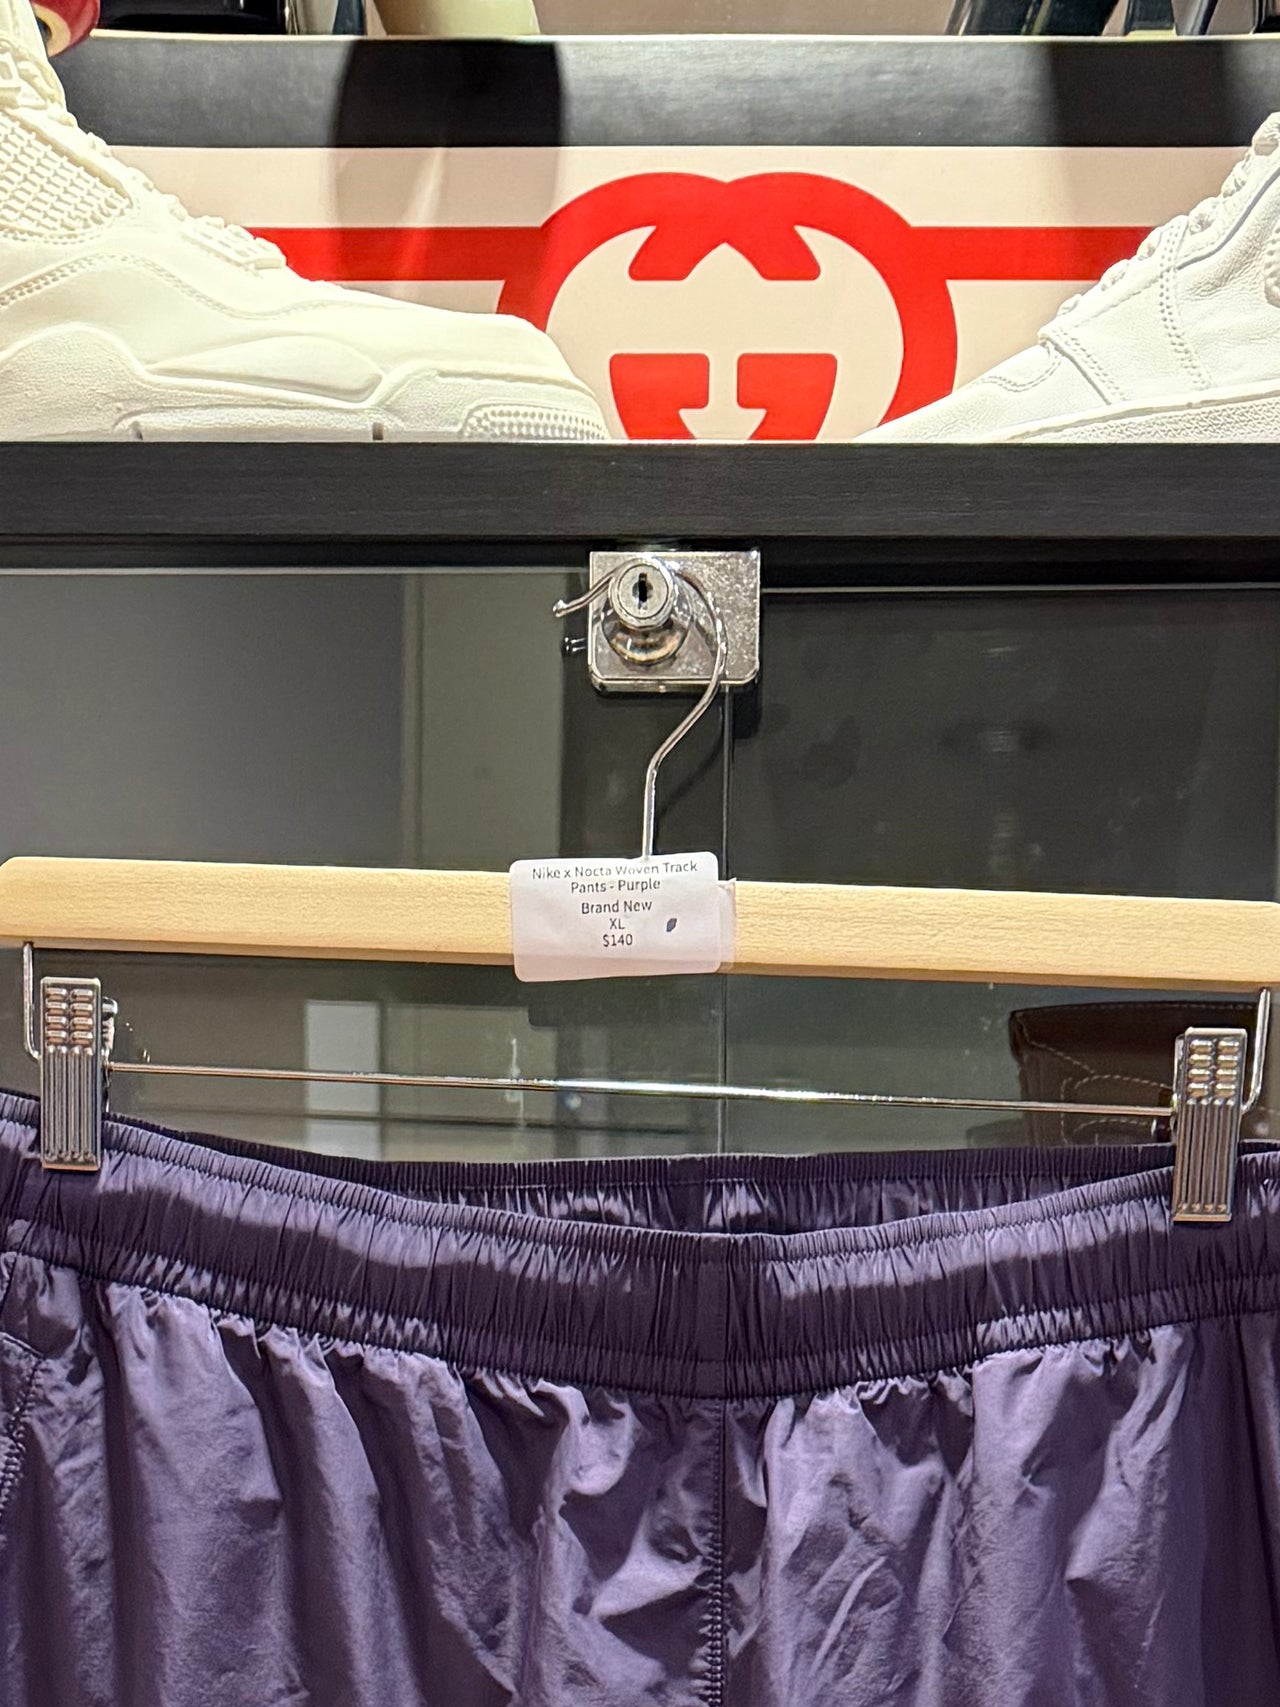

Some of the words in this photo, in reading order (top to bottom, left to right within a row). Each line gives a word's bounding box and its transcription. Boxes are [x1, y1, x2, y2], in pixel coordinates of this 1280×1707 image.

[532, 867, 561, 880] Nike
[564, 870, 571, 879] x
[575, 866, 612, 878] Nocta
[615, 865, 659, 876] Woven
[663, 860, 698, 874] Track
[571, 881, 607, 894] Pants
[618, 878, 661, 893] Purple
[581, 900, 620, 915] Brand
[623, 901, 652, 913] New
[609, 918, 626, 930] XL
[603, 933, 634, 948] $140
